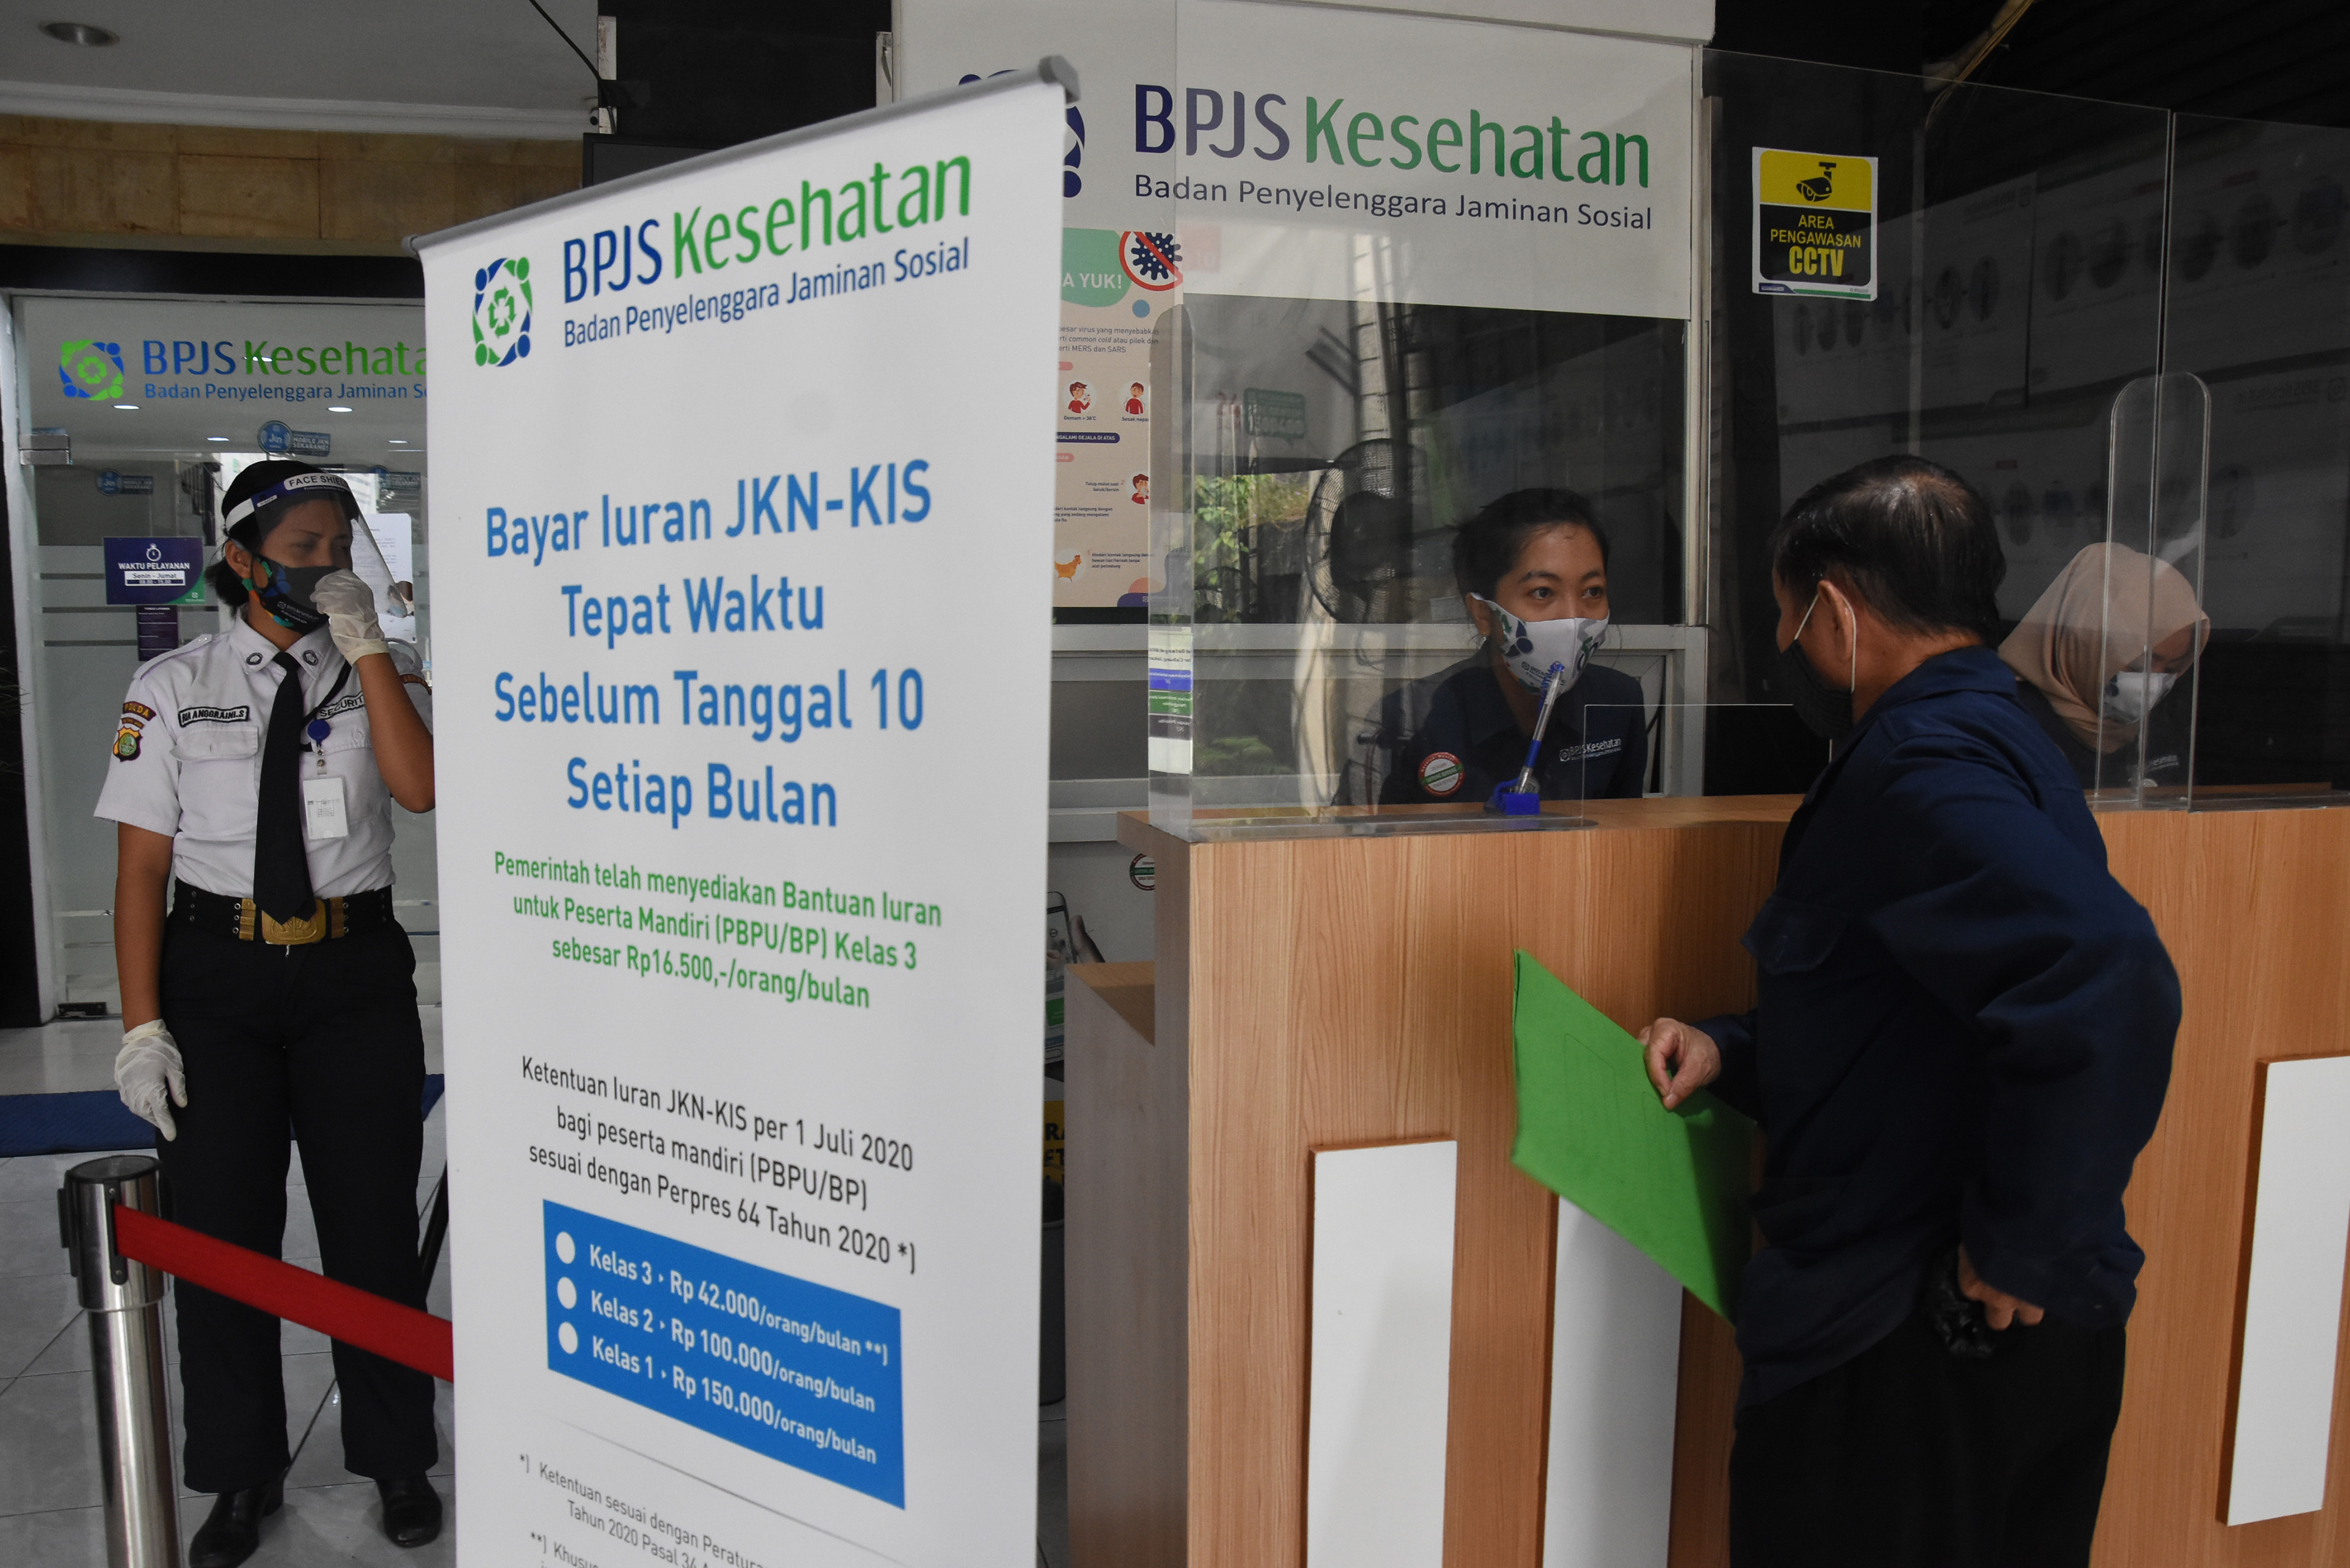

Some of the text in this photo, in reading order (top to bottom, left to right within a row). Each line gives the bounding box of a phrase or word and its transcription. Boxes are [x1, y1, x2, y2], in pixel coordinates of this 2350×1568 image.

[1134, 83, 1650, 189] BPJS Kesehatan
[563, 155, 971, 304] BPJS Kesehatan
[1135, 173, 1652, 230] Badan Penyelenggara Jaminan Sosial
[1770, 229, 1861, 248] PENGAWASAN
[1798, 214, 1834, 230] AREA
[565, 236, 969, 348] Badan Penyelenggara Jaminan Sosial
[1080, 273, 1122, 288] YUK!
[1789, 246, 1844, 277] CCTV
[143, 340, 236, 375] BPJS
[145, 383, 200, 399] Badan
[205, 383, 332, 401] Penyelenggara
[337, 383, 407, 399] Jaminan
[288, 475, 318, 486] FACE
[486, 459, 932, 567] Bayar Iuran JKN-KIS
[560, 574, 824, 650] Tepat Waktu
[125, 703, 149, 717] POLDA
[494, 667, 924, 744] Sebelum Tanggal 10
[1586, 738, 1622, 753] Kesehatan
[566, 757, 837, 830] Setiap Bulan
[495, 851, 942, 928] Pemerintah telah menyediakan Bantuan Iuran
[513, 893, 917, 971] untuk Peserta Mandiri (PBPU/BP) Kelas 3
[552, 936, 870, 1009] sebesar Rp16.500,-/orang/bulan
[522, 1056, 912, 1172] Ketentuan Iuran JKN-KIS per 1 Juli 2020
[558, 1104, 867, 1211] bagi peserta mandiri (PBPU/BP)
[529, 1145, 581, 1176] sesuai
[587, 1156, 651, 1195] dengan
[658, 1174, 731, 1218] Perpres
[737, 1198, 760, 1227] 64
[766, 1205, 830, 1248] Tahun
[838, 1225, 889, 1264] 2020
[590, 1244, 637, 1281] Kelas
[642, 1261, 652, 1285] 3
[670, 1270, 694, 1304] Rp
[698, 1280, 861, 1356] 42.000/orang/bulan
[591, 1290, 875, 1412] Kelas 2 Rp 100.000/orang/bulan
[592, 1335, 877, 1464] Kelas 1 Rp 150.000/orang/bulan
[540, 1462, 602, 1504] Ketentuan
[606, 1494, 646, 1525] sesuai
[650, 1512, 698, 1548] dengan
[568, 1499, 605, 1532] Tahun
[609, 1519, 638, 1547] 2020
[642, 1533, 679, 1566] Pasal
